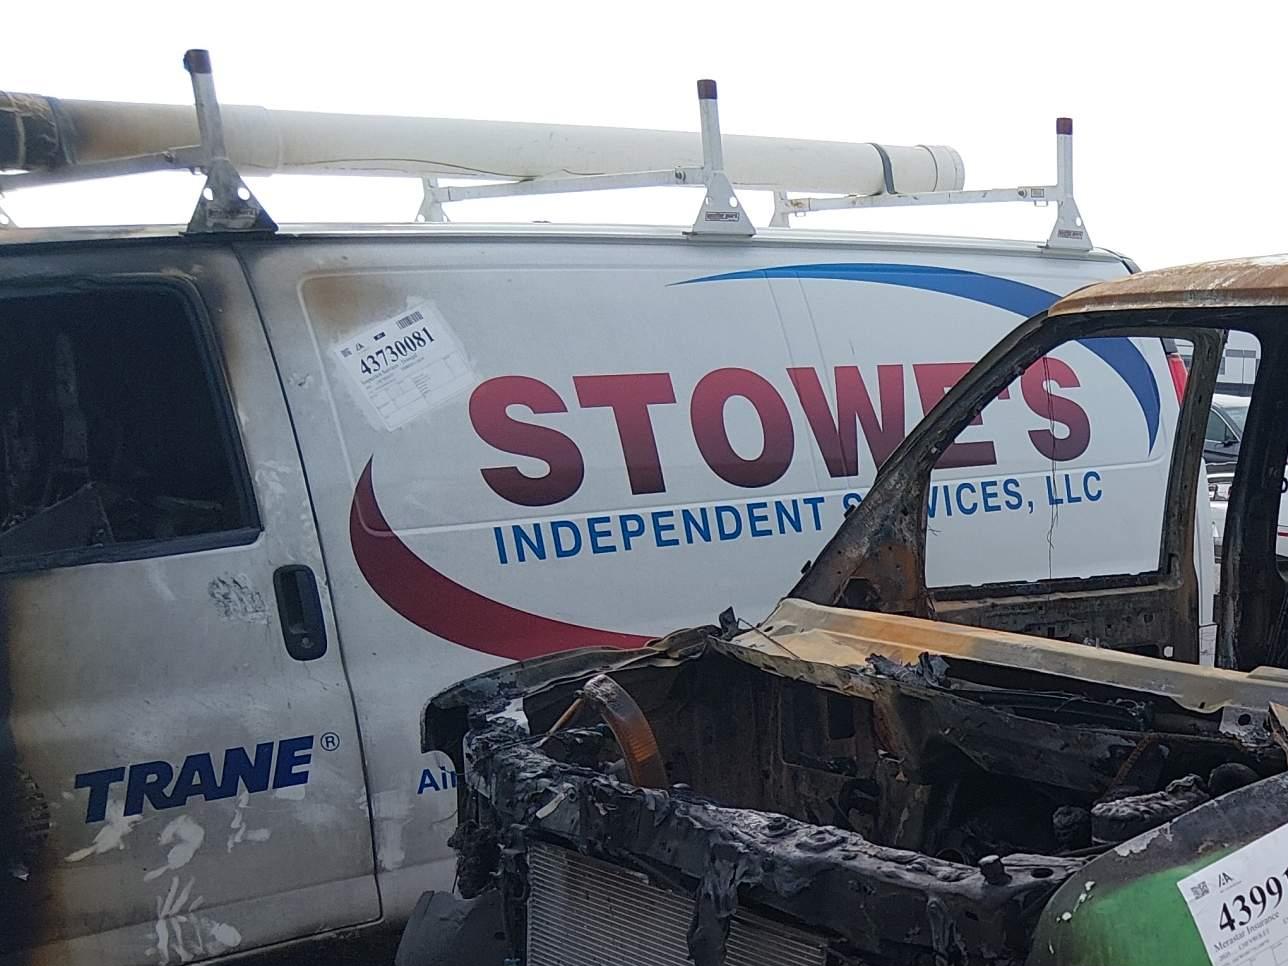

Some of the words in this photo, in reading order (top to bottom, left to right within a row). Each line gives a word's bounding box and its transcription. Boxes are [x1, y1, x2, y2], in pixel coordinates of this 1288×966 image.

[360, 326, 435, 375] 43730081
[469, 356, 1092, 508] STOWES
[493, 496, 825, 565] INDEPENDENT
[842, 478, 1034, 518] VICES,
[1045, 471, 1103, 506] LLC
[1246, 911, 1280, 935] Insurance
